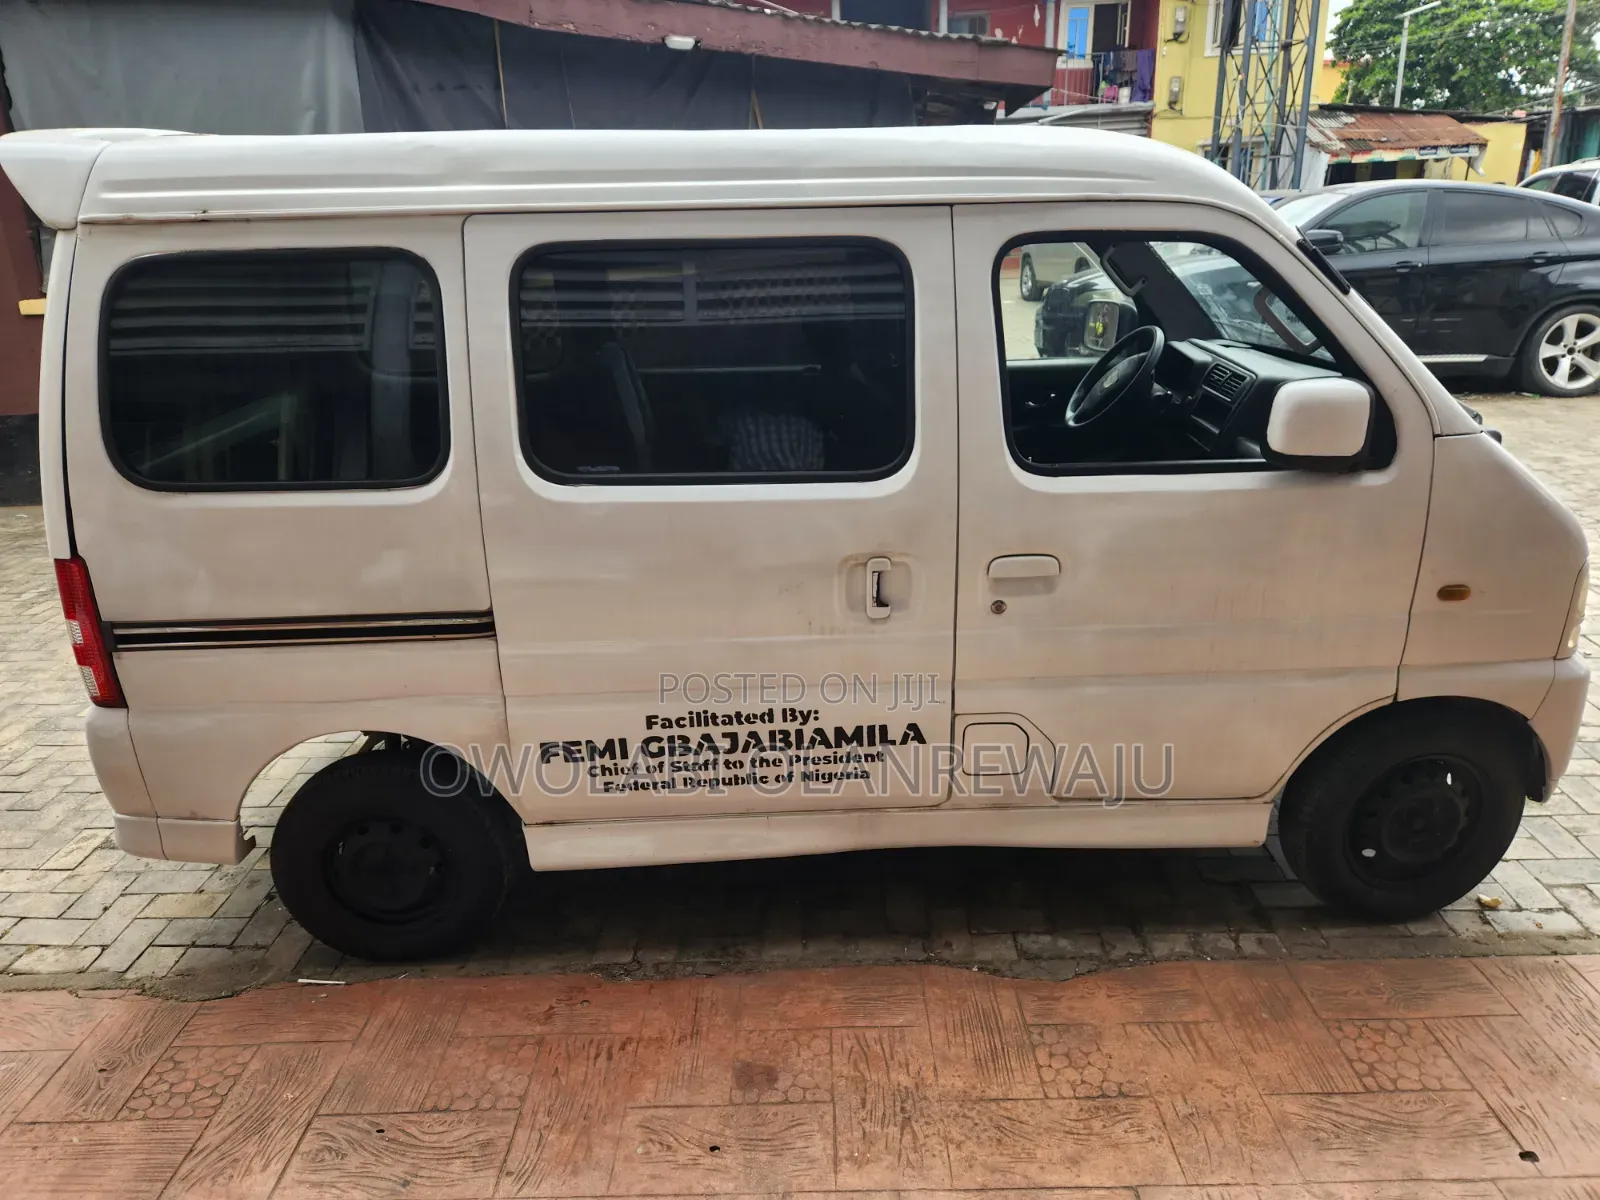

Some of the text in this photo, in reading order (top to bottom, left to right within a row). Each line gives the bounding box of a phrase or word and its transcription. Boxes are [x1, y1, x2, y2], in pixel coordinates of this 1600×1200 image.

[645, 708, 820, 730] Facilitated By:
[539, 722, 927, 764] FEMI GBAJABIAMILA
[587, 751, 885, 778] Chief of Staff to the President
[603, 766, 871, 793] Federal Republic of Nigeria
